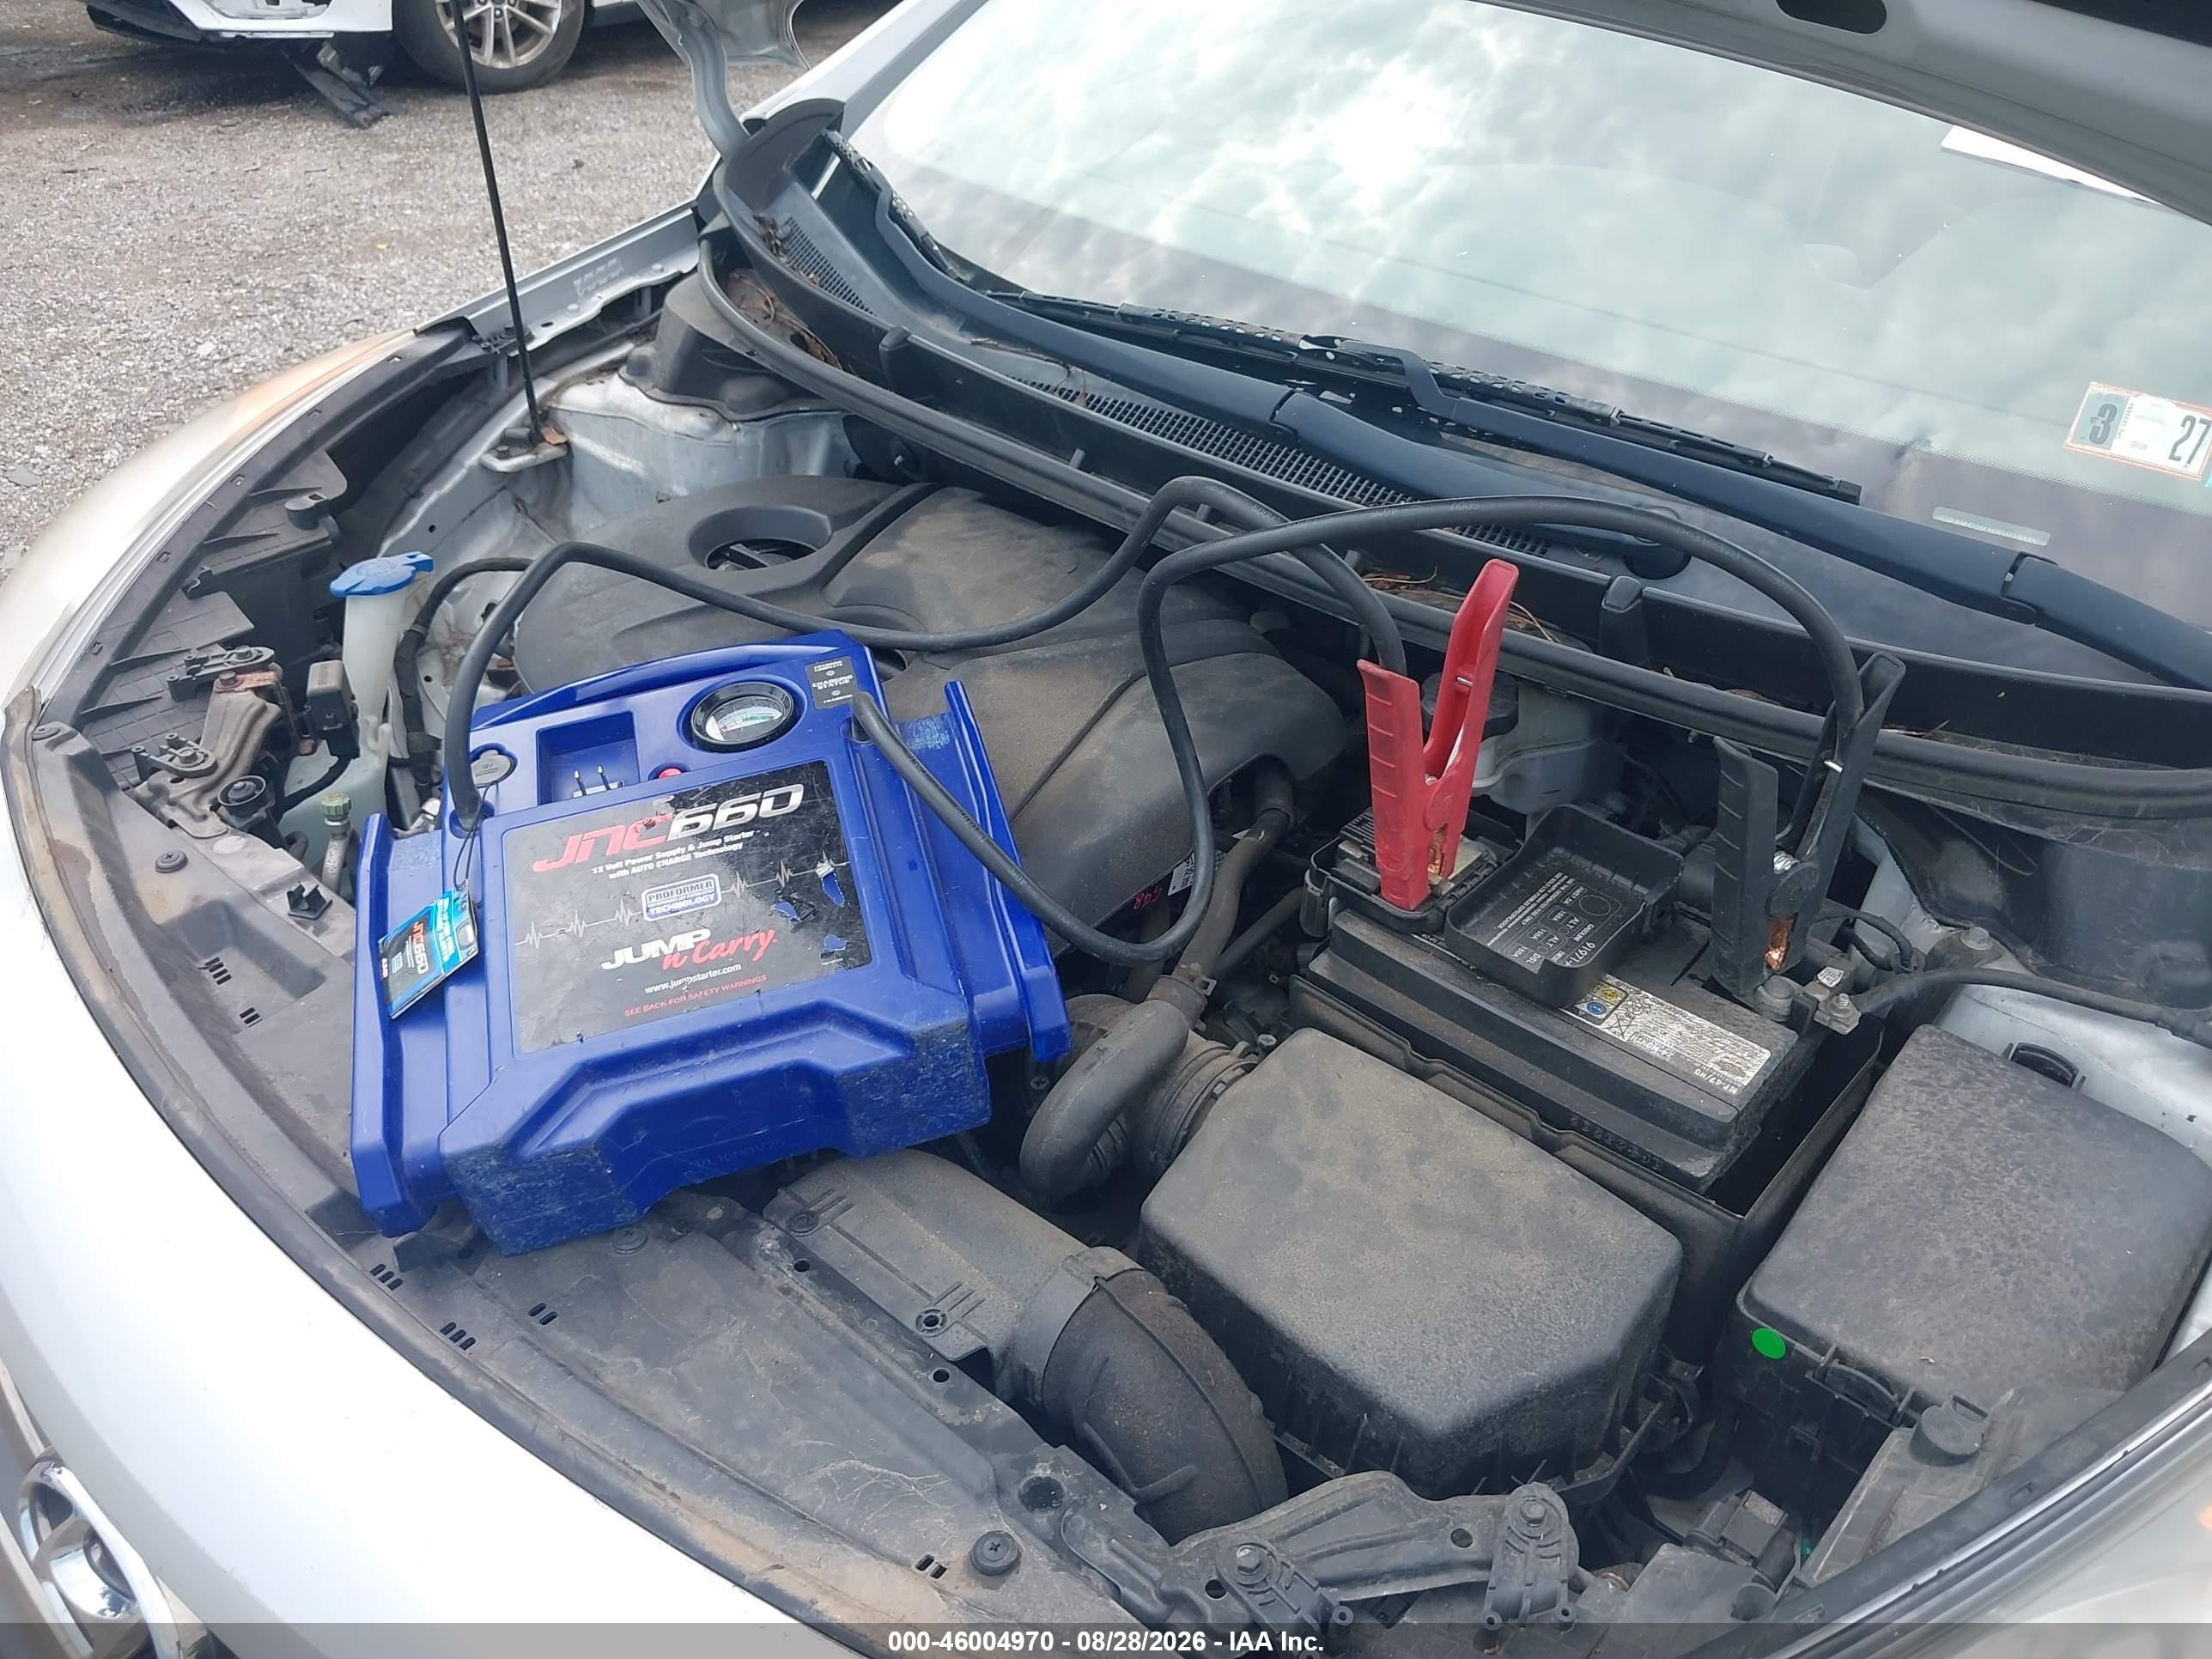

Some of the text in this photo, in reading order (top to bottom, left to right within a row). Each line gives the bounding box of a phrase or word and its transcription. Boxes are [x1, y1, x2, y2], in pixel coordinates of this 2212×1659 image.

[2089, 403, 2118, 445] 3
[2168, 415, 2212, 465] 27
[812, 675, 854, 688] CHARGING
[817, 679, 850, 690] STATUS
[605, 861, 624, 872] Volt
[624, 854, 654, 867] Power
[654, 846, 687, 860] Supply
[697, 836, 722, 849] Jump
[723, 830, 755, 842] Starter
[608, 842, 744, 880] with AUTO CHARGE Technology
[648, 880, 713, 902] PROFORMER
[650, 894, 715, 915] TECHNOLOGY
[601, 928, 712, 970] JUMP
[692, 928, 776, 963] Carry
[1525, 916, 1580, 964] ALT ALT DSL
[1572, 923, 1595, 942] GASOLINE
[624, 975, 768, 1017] SEE BACK FOR SAFETY WARNINGS
[645, 963, 742, 994] www.jumpstarter.com
